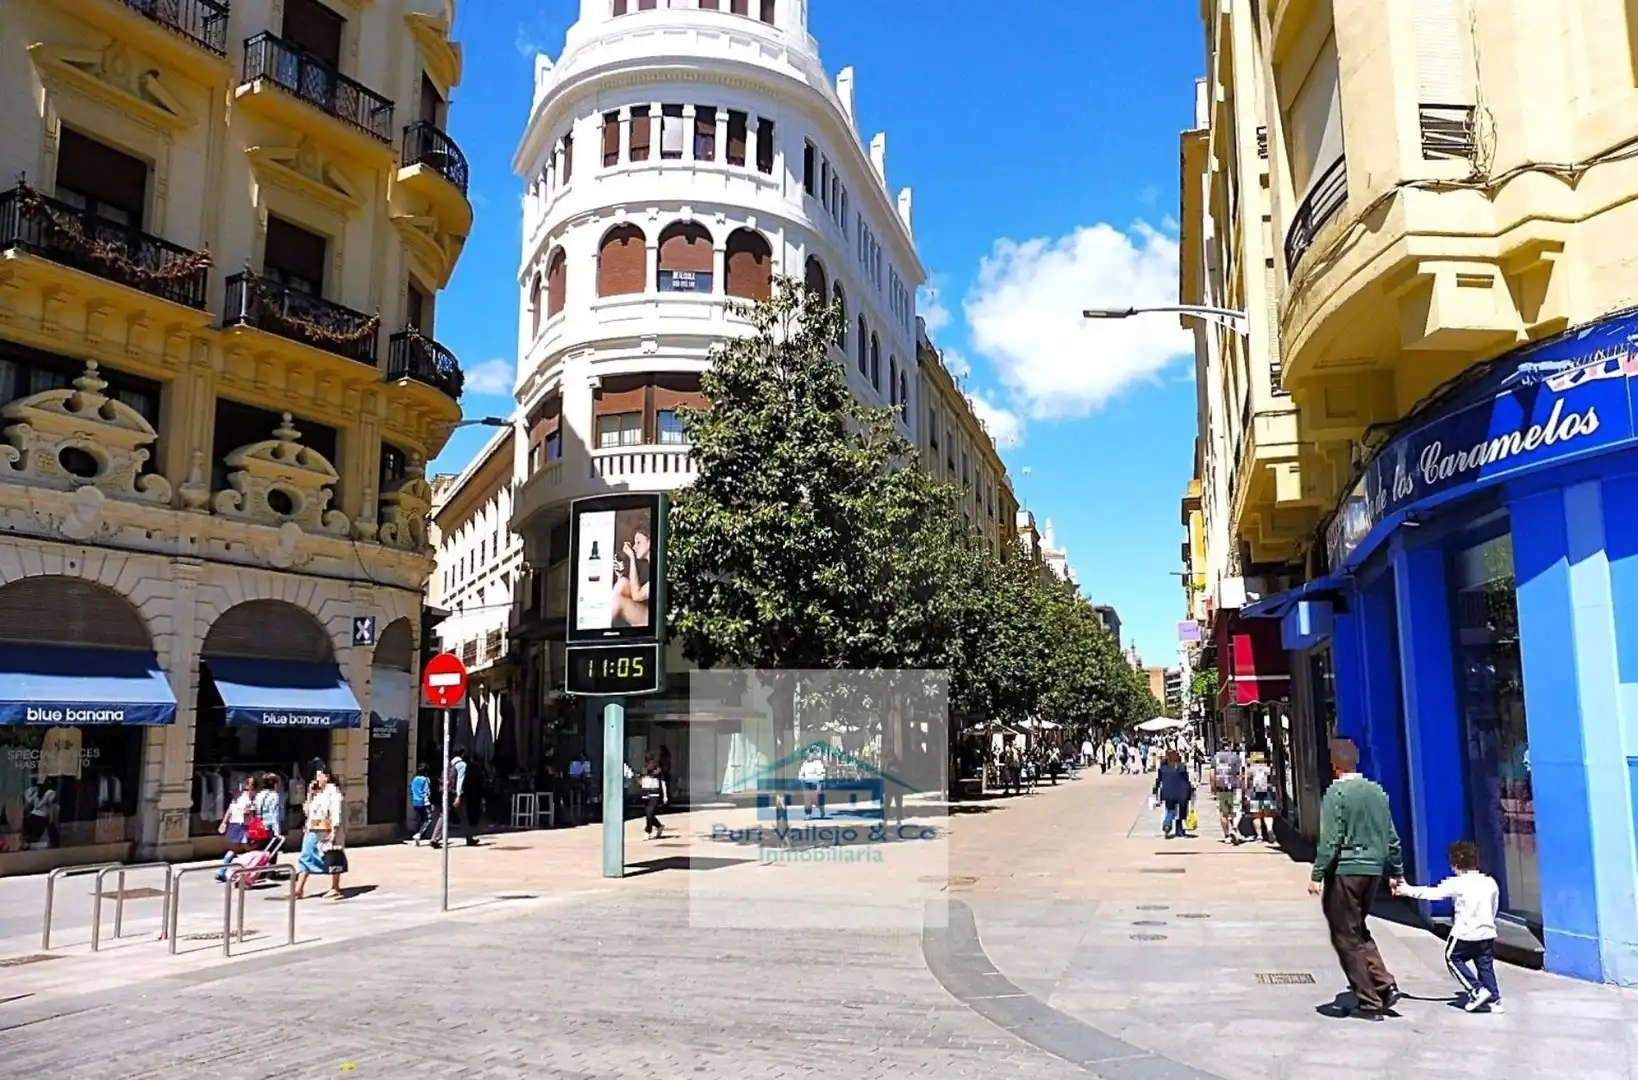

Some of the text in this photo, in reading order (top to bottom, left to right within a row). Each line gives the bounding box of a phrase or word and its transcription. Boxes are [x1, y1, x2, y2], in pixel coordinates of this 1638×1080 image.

[1392, 463, 1414, 502] los
[1419, 397, 1600, 486] Caramelos
[588, 656, 644, 678] 11:05
[26, 706, 125, 721] blue banana
[262, 712, 331, 726] blue banana
